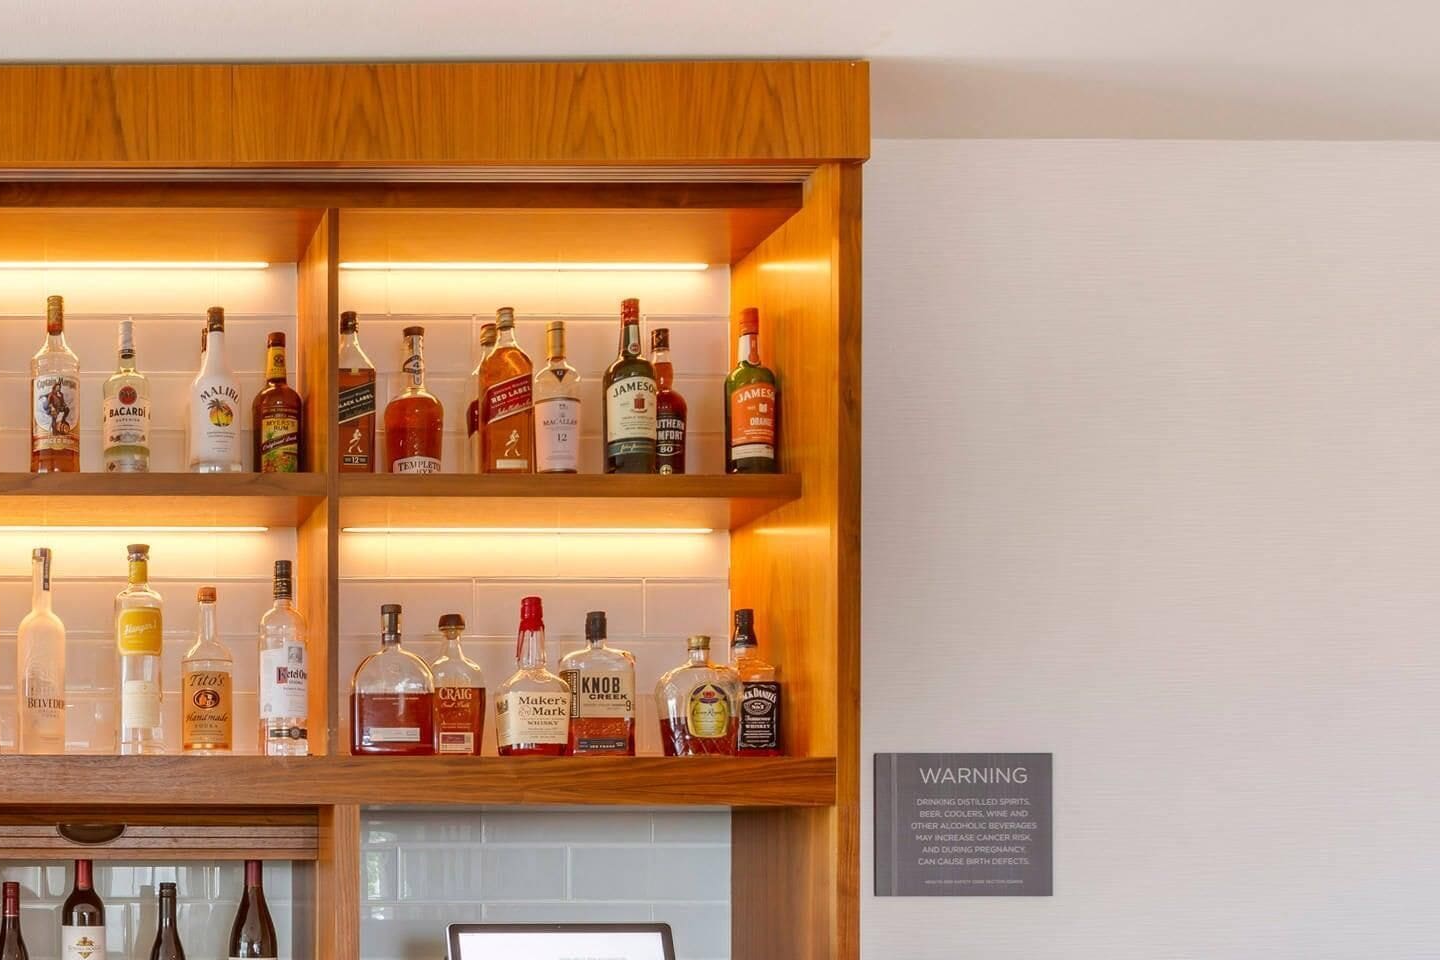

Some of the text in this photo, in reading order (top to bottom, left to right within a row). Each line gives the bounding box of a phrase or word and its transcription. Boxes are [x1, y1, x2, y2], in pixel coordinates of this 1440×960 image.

[200, 385, 240, 405] MALIBU
[490, 392, 507, 404] RED
[656, 418, 686, 431] UTHERN
[557, 433, 568, 442] 12
[189, 672, 226, 688] Tito's
[582, 677, 621, 694] KNOB
[438, 687, 472, 701] CRAIG
[518, 695, 568, 706] Maker's
[532, 706, 566, 717] Mark
[919, 767, 1029, 785] WARNING
[916, 798, 956, 806] DRINKING
[957, 798, 998, 806] DISTILLED
[986, 810, 1009, 818] WINE
[911, 822, 1038, 830] OTHER ALCOHOLIC BEVERAGES
[915, 834, 933, 842] MAY
[934, 834, 975, 842] INCREASE
[976, 834, 1010, 842] CANCER
[941, 846, 973, 854] DURING
[918, 857, 936, 866] CAN
[937, 857, 965, 865] CAUSE
[966, 857, 991, 865] BIRTH
